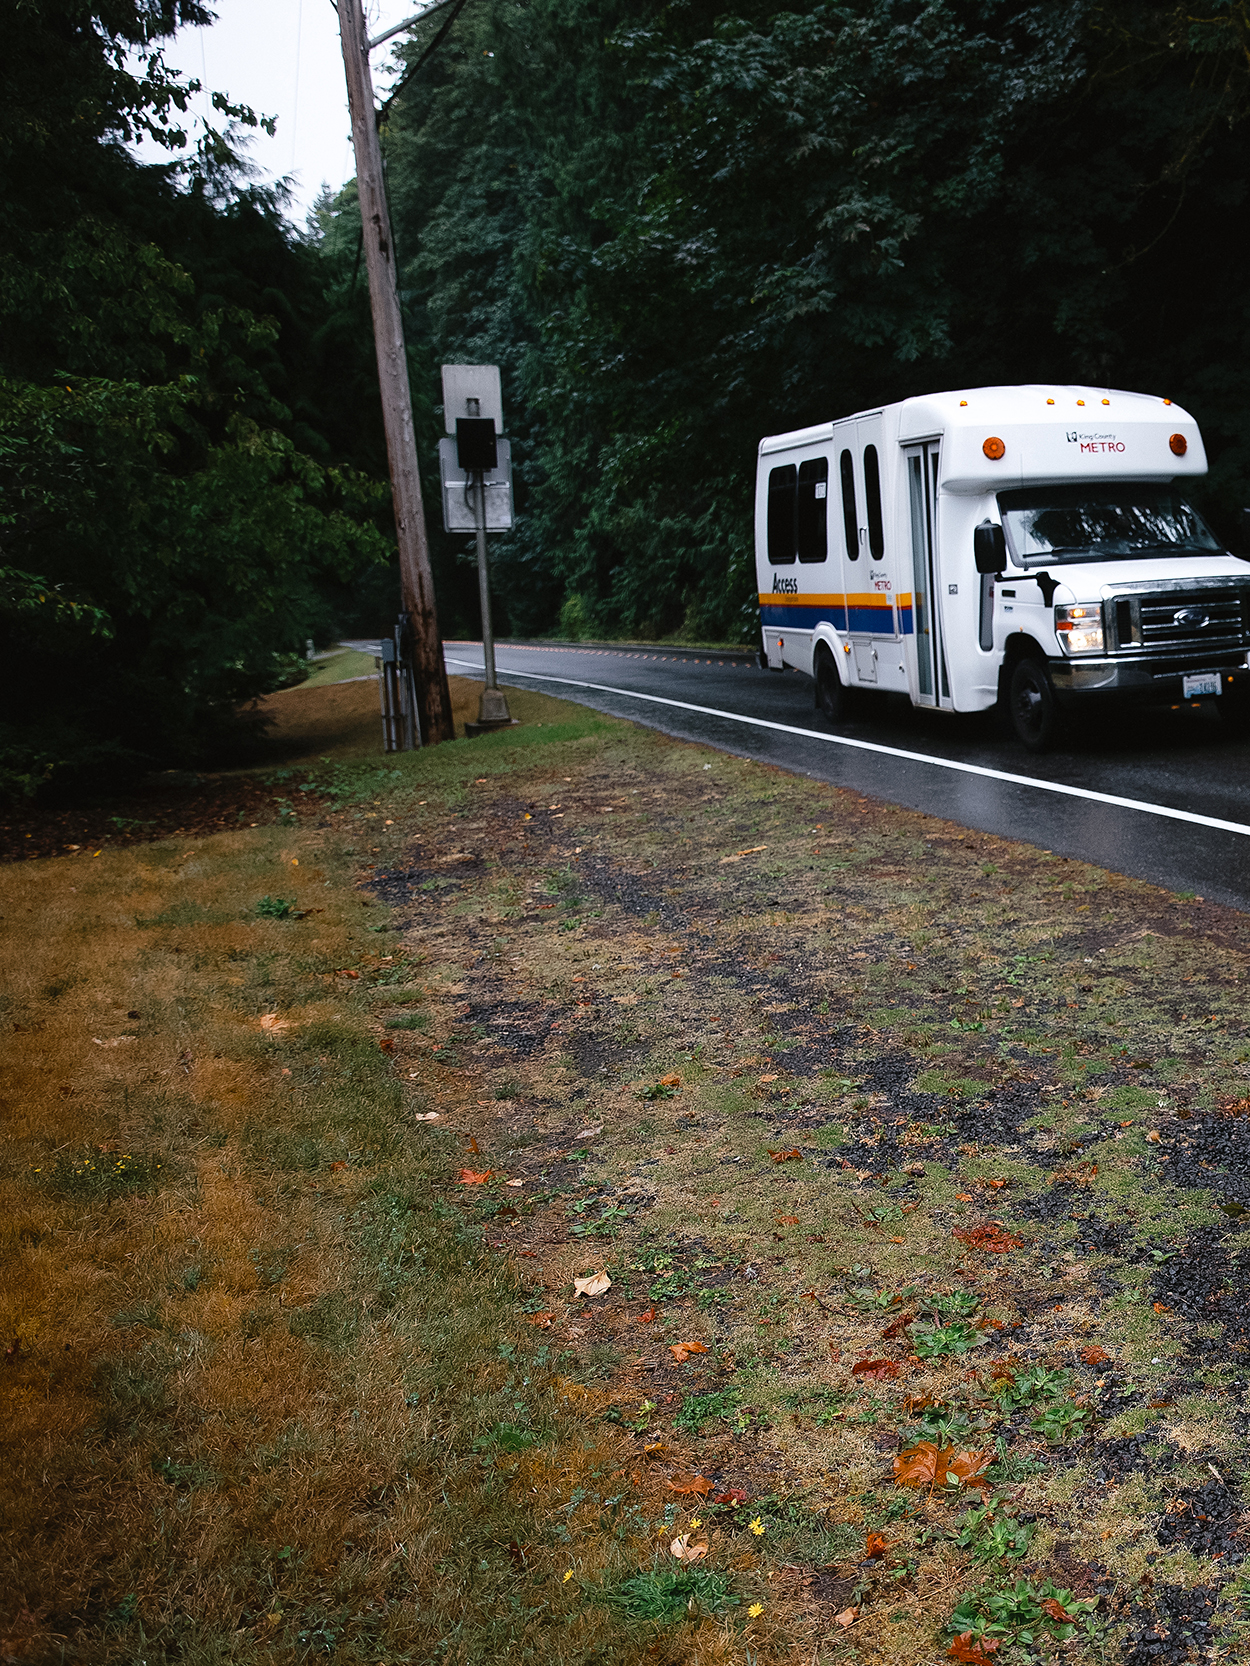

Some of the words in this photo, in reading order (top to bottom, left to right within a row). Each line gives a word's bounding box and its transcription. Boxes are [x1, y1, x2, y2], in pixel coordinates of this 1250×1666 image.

[1080, 442, 1125, 453] METRO
[772, 572, 798, 594] Access
[874, 580, 892, 591] METRO
